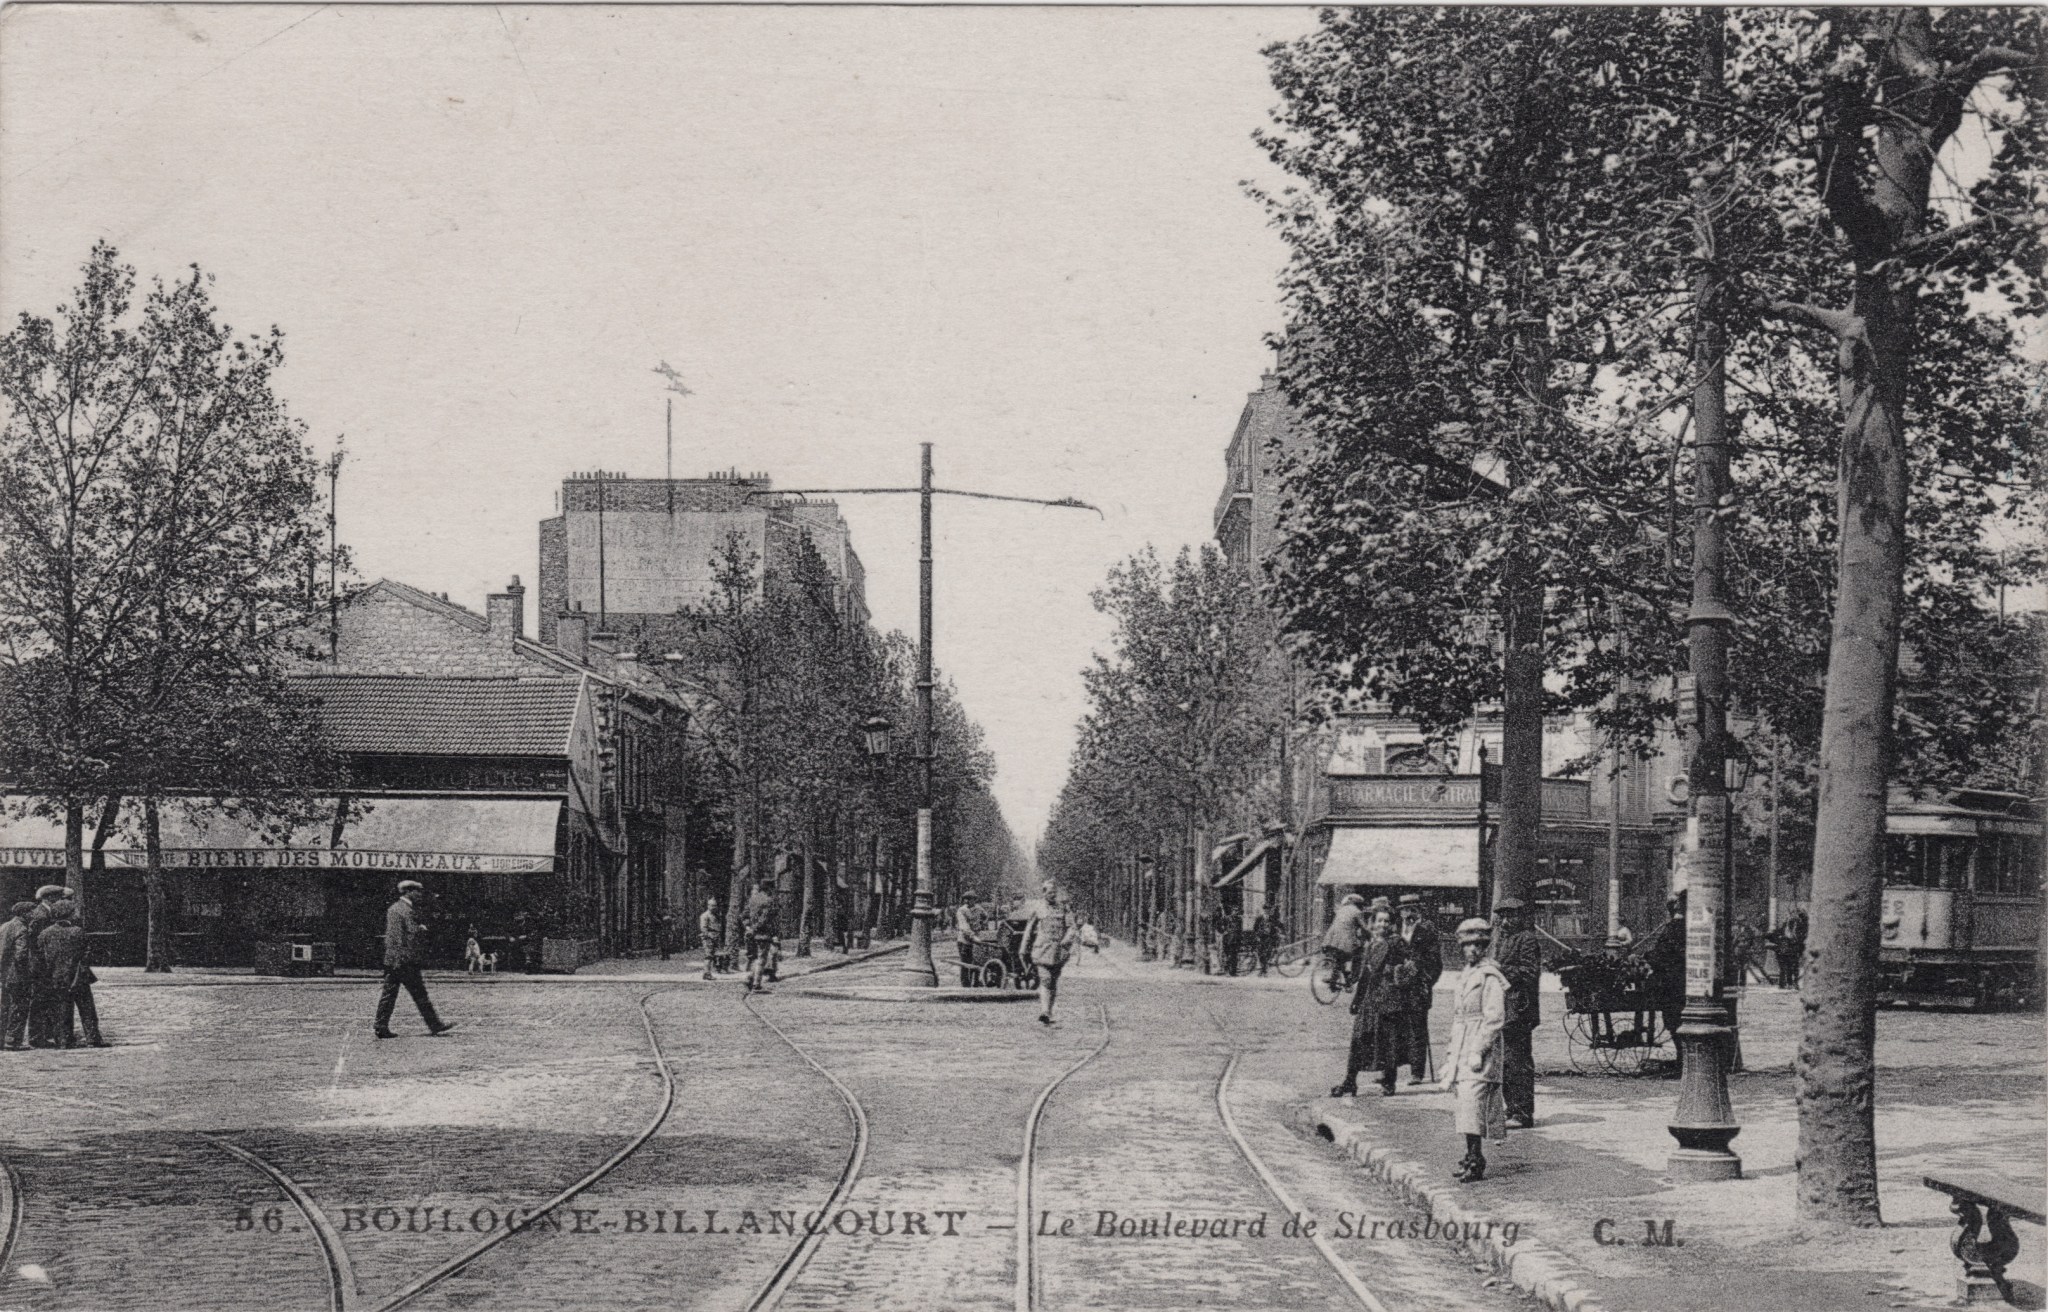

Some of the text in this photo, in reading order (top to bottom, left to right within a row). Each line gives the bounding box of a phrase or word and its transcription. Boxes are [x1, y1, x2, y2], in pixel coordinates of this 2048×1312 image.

[187, 851, 265, 867] BIERE
[277, 850, 321, 868] DES
[330, 851, 481, 871] MOULINEAUX
